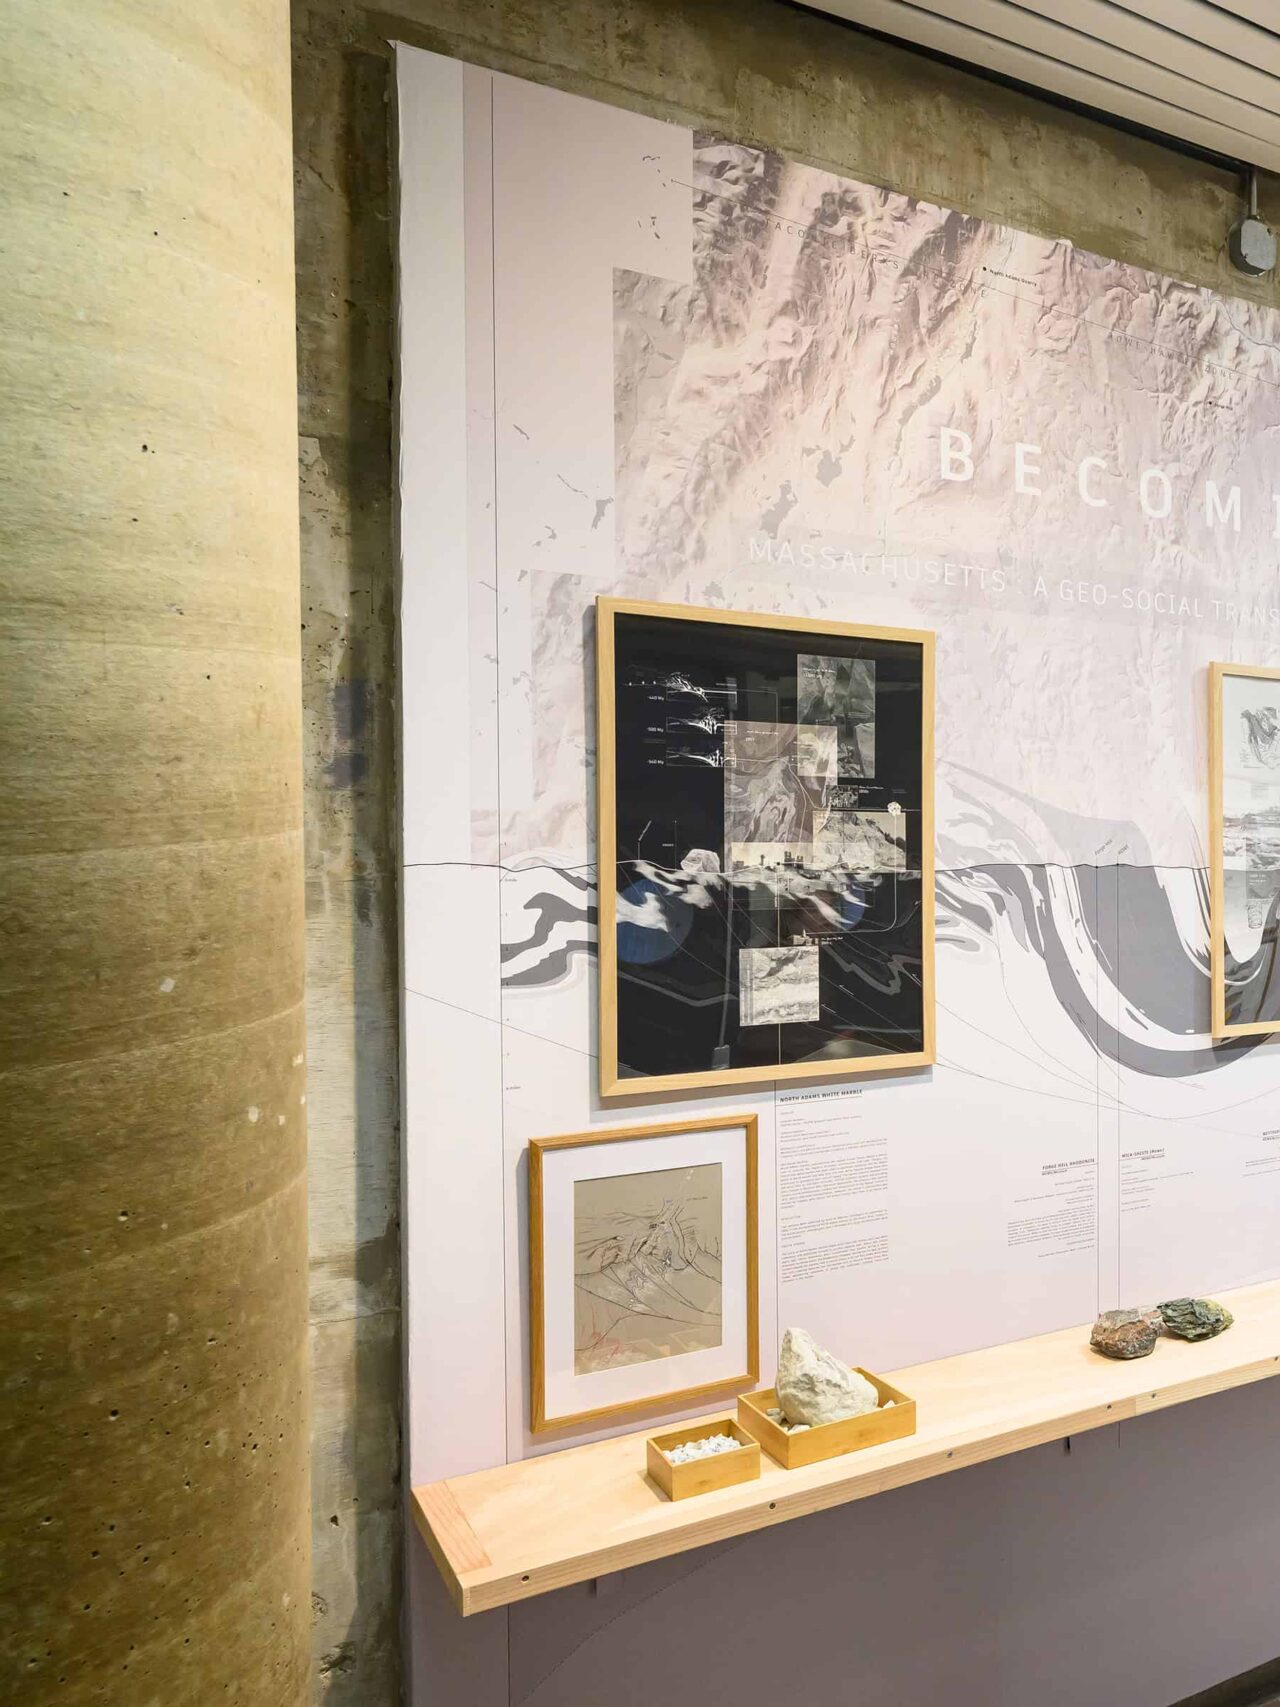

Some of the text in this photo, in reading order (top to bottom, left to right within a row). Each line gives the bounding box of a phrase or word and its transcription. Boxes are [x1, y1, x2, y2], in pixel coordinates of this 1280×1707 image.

[748, 537, 1006, 593] MASSACHUSETTS
[1033, 575, 1049, 599] A
[1059, 579, 1204, 619] GEO-SOCIAL
[779, 1088, 863, 1103] NORTH ADAMS WHITE MARBLE
